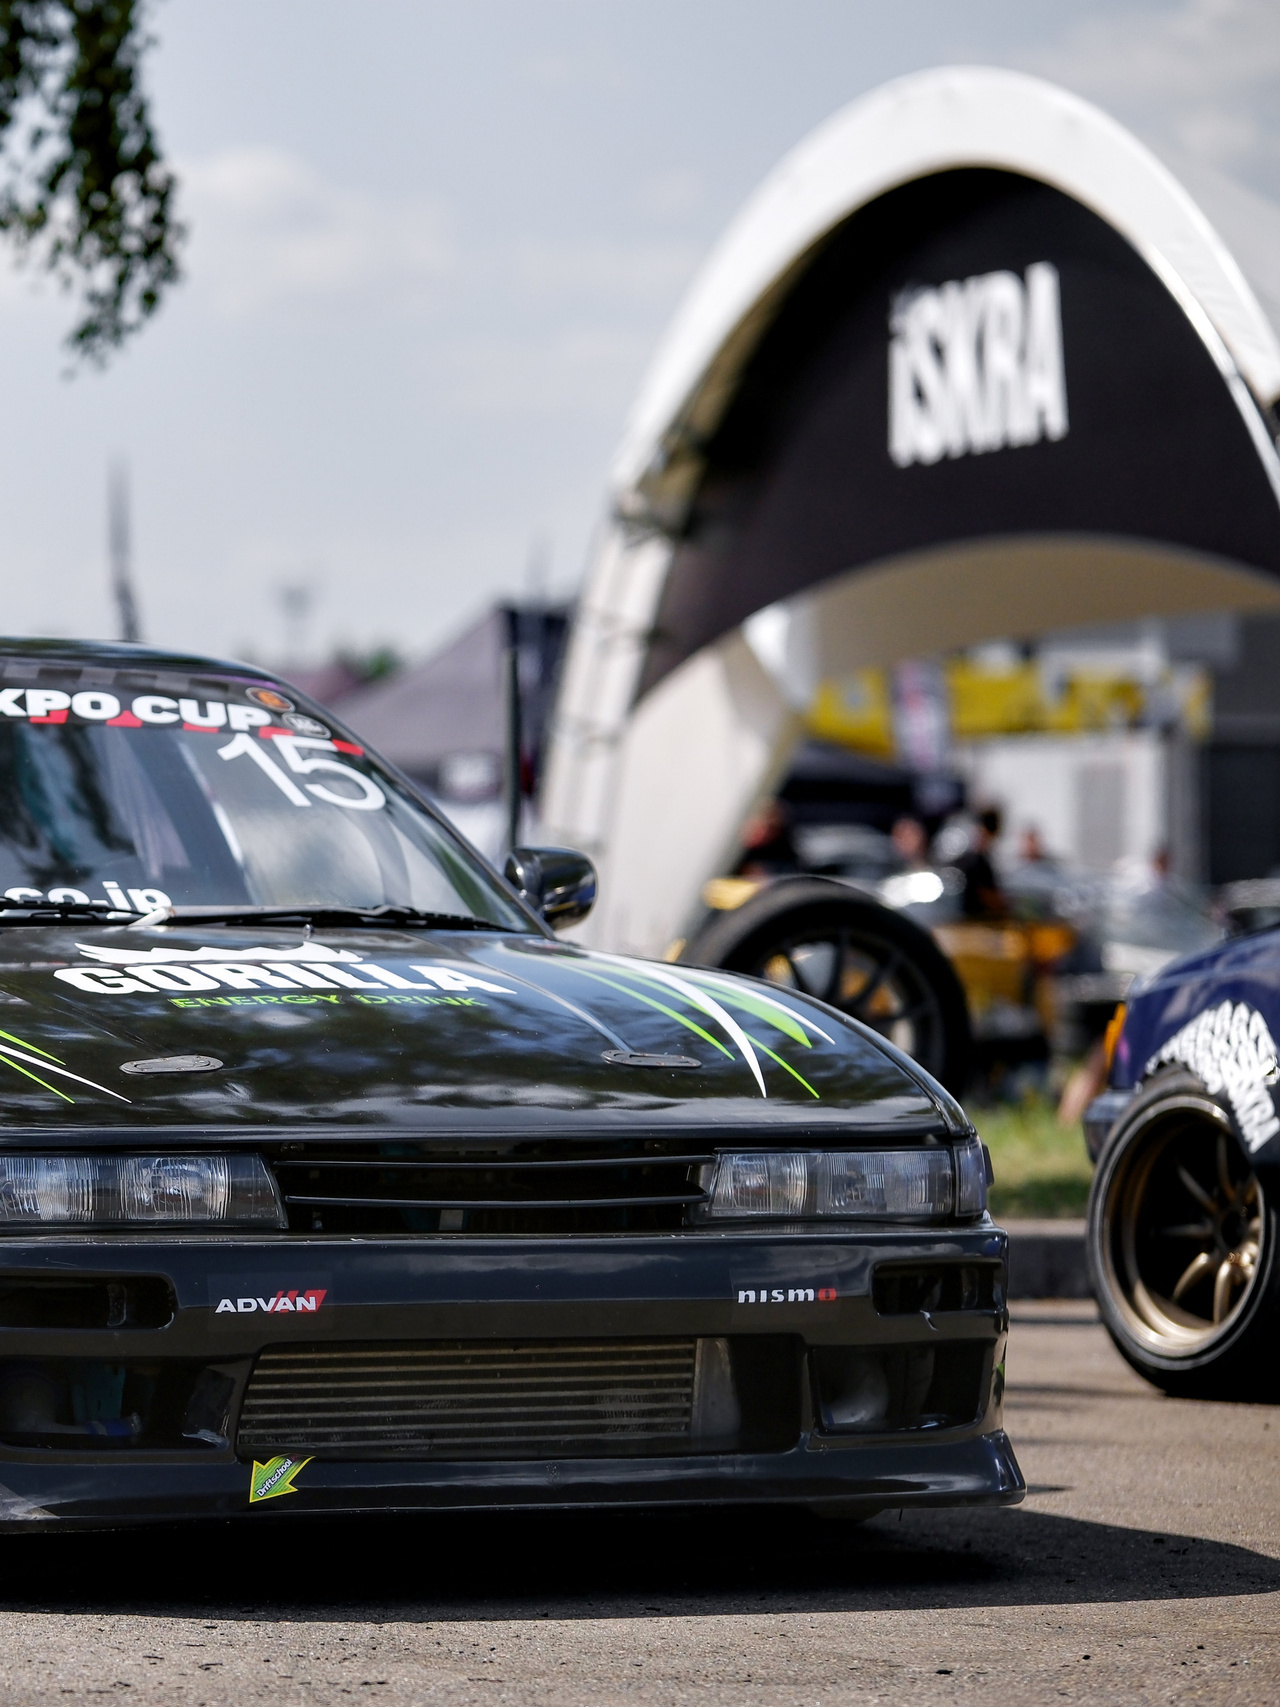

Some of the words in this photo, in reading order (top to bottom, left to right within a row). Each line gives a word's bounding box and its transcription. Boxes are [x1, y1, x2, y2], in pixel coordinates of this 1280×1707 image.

[132, 695, 271, 731] CUP
[217, 733, 386, 811] 15
[53, 963, 517, 994] GORILLA
[170, 994, 343, 1009] ENERGY
[356, 993, 488, 1007] DRINK
[214, 1296, 317, 1314] ADVAN
[738, 1288, 837, 1303] nismo
[255, 1458, 293, 1497] Driftschool
